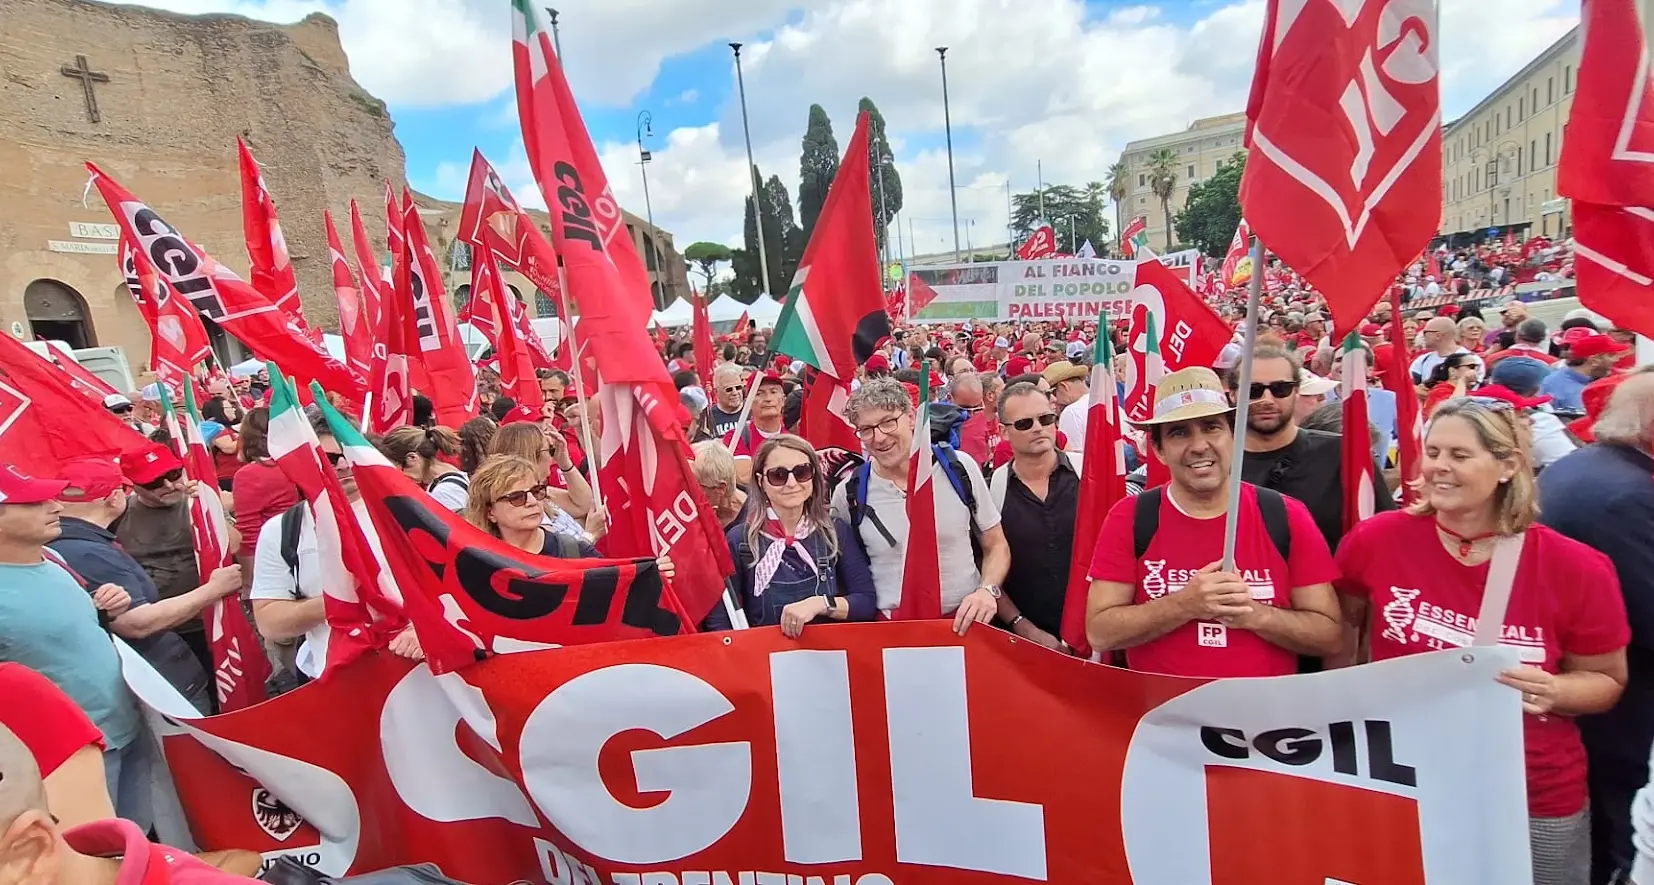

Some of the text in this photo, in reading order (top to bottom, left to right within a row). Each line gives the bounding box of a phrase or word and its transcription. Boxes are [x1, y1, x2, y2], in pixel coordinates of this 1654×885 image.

[1024, 263, 1122, 279] AL FIANCO
[1014, 280, 1131, 297] DEL POPOLO
[1008, 299, 1133, 318] PALESTINESE
[385, 496, 681, 636] CGIL
[1168, 569, 1272, 582] ESSALI
[1418, 601, 1545, 641] ESSENIALI
[1203, 626, 1222, 638] FP
[380, 645, 1048, 880] CGIL
[1200, 720, 1417, 787] CGIL
